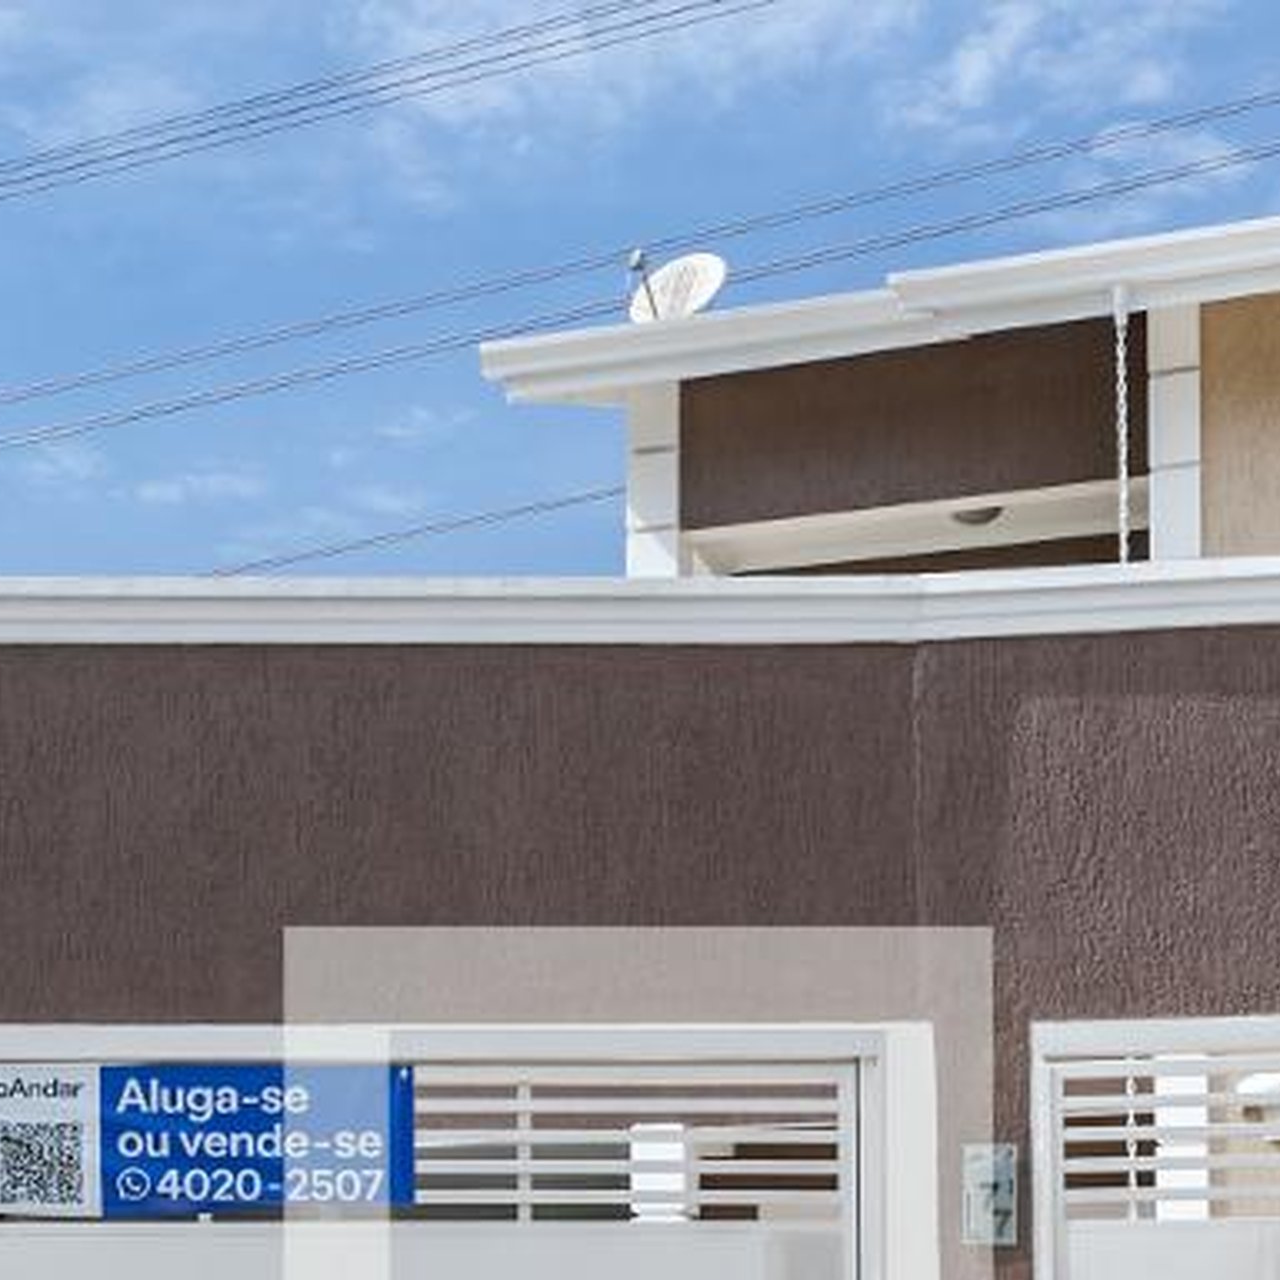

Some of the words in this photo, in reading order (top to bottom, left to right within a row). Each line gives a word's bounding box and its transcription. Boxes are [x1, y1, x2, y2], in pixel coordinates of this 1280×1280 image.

[116, 1077, 310, 1122] Aluga-se
[117, 1130, 170, 1158] ou
[179, 1123, 383, 1158] vende-se
[155, 1167, 384, 1201] 4020-2507
